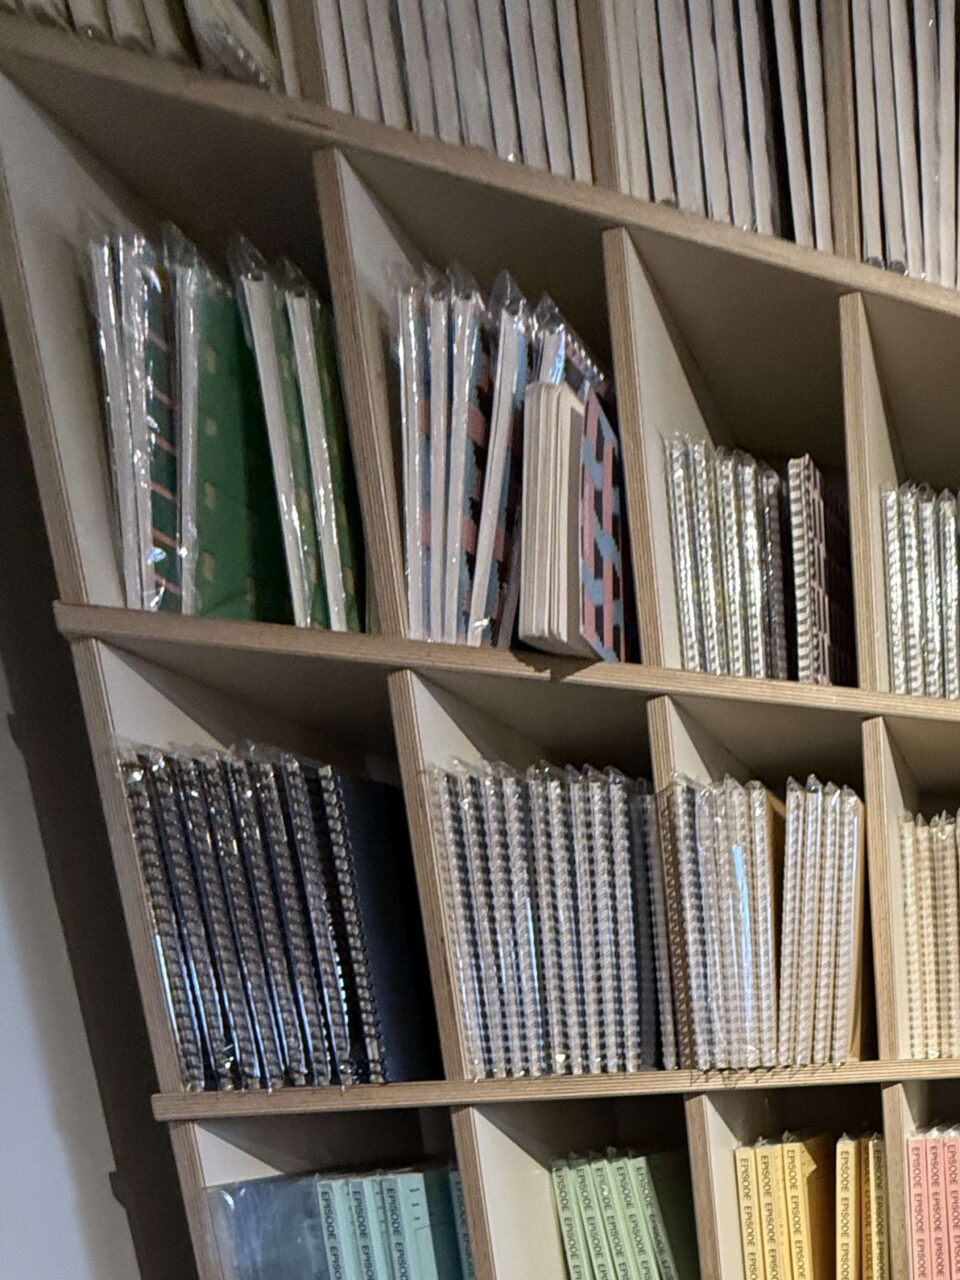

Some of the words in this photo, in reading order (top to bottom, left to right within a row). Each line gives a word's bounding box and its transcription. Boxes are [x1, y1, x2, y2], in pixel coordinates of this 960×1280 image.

[741, 1158, 751, 1199] EPISODE
[761, 1156, 772, 1197] EPISODE
[787, 1150, 798, 1190] EPISODE
[841, 1151, 849, 1192] EPISODE
[874, 1151, 882, 1190] EPISODE
[912, 1147, 922, 1188] EPISODE
[931, 1146, 939, 1186] EPISODE
[948, 1144, 958, 1184] EPISODE
[636, 1167, 653, 1209] EPISODE
[322, 1191, 336, 1240] EPISODE
[352, 1190, 368, 1238] EPISODE
[387, 1188, 401, 1235] EPISODE
[554, 1169, 569, 1211] EPISODE
[564, 1217, 578, 1260] EPISODE
[576, 1169, 592, 1210] EPISODE
[587, 1217, 603, 1258] EPISODE
[617, 1167, 633, 1209] EPISODE
[629, 1214, 646, 1255] EPISODE
[744, 1206, 755, 1246] EPISODE
[765, 1203, 776, 1244] EPISODE
[791, 1195, 802, 1234] EPISODE
[841, 1198, 849, 1238] EPISODE
[876, 1196, 884, 1235] EPISODE
[914, 1194, 923, 1233] EPISODE
[932, 1192, 941, 1232] EPISODE
[951, 1190, 960, 1229] EPISODE
[607, 1216, 624, 1257] EPISODE
[935, 1237, 944, 1276] EPISODE
[795, 1240, 806, 1278] EPISODE
[917, 1239, 926, 1278] EPISODE
